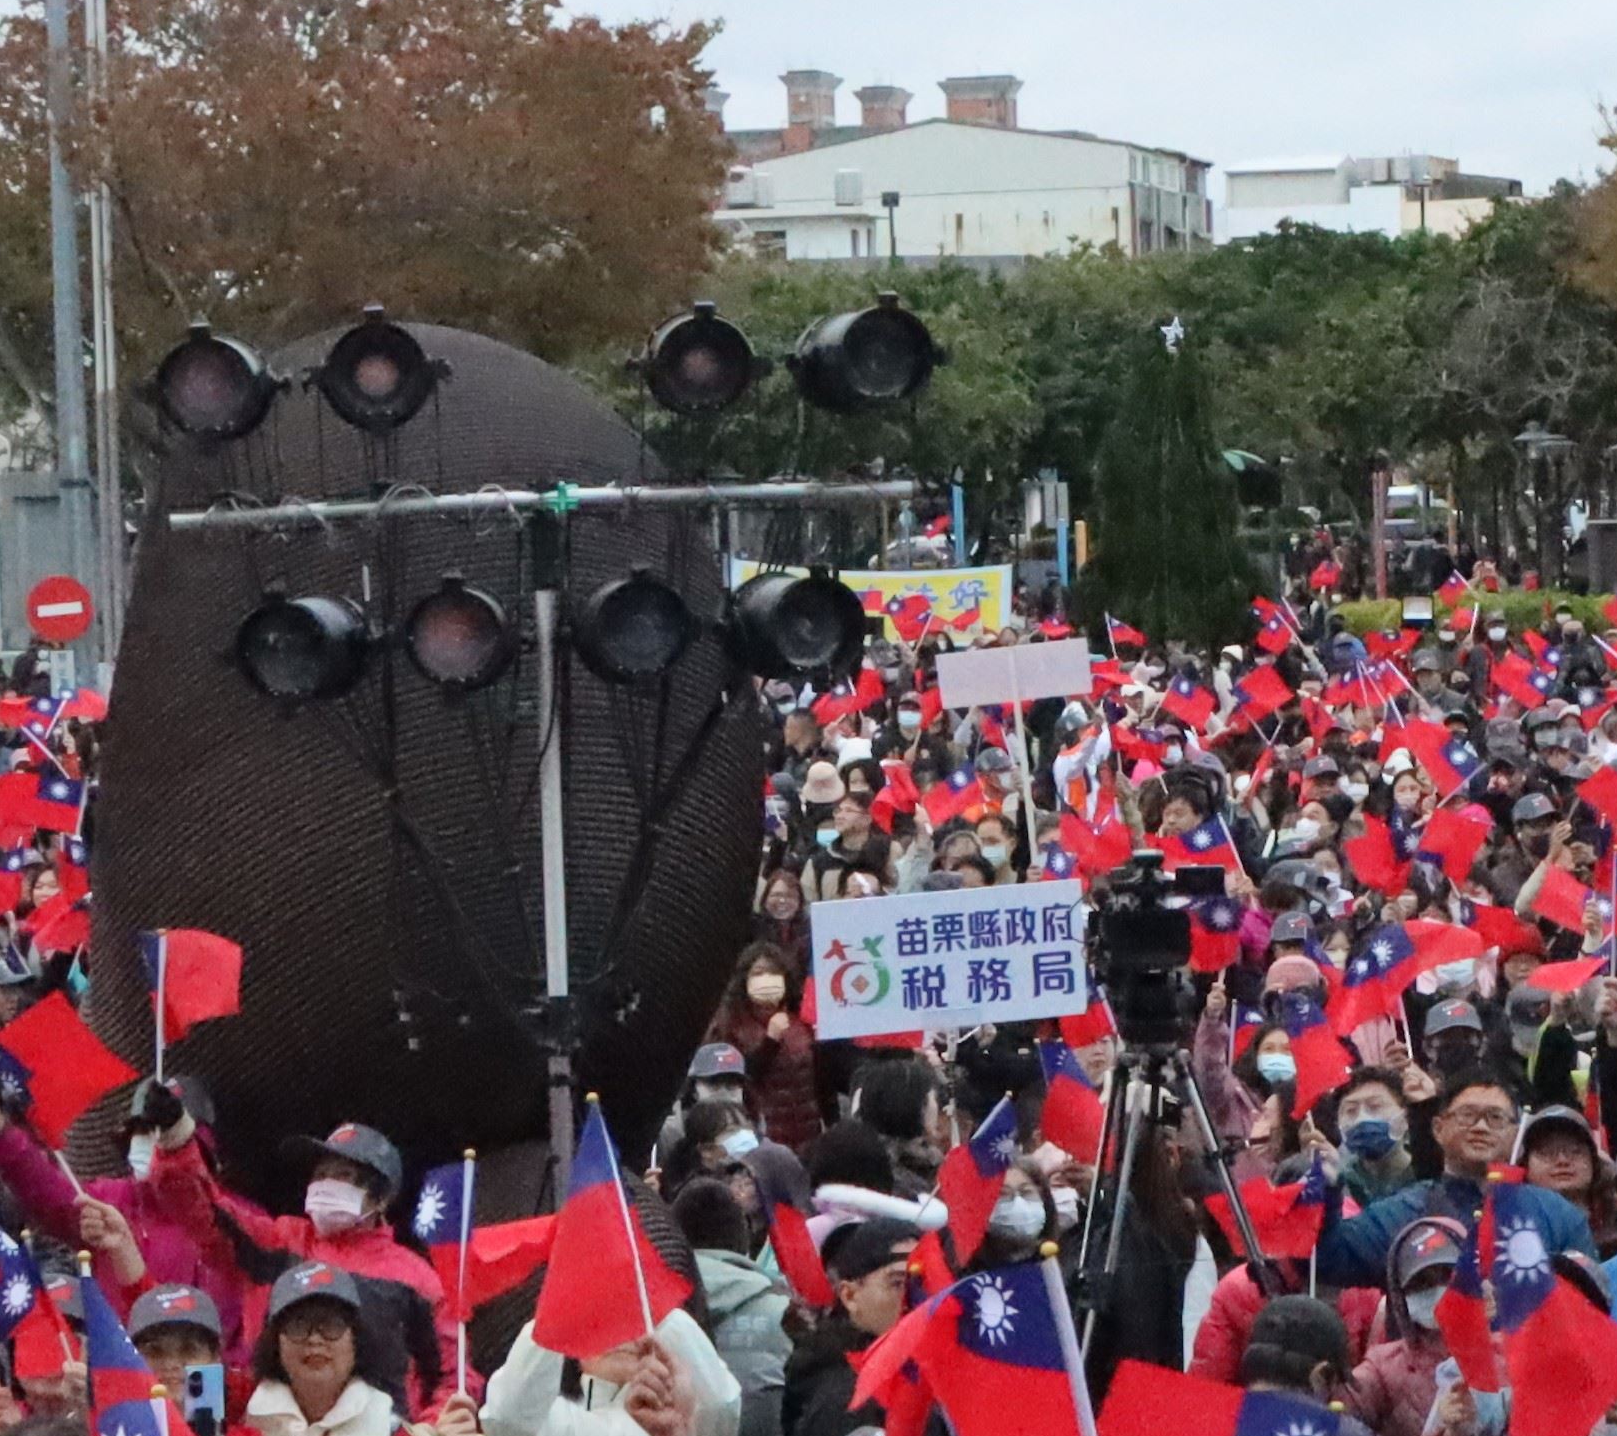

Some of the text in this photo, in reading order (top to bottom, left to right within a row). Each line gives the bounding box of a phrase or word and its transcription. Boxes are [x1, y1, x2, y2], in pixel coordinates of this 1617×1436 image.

[896, 903, 1074, 957] 苗栗縣政府
